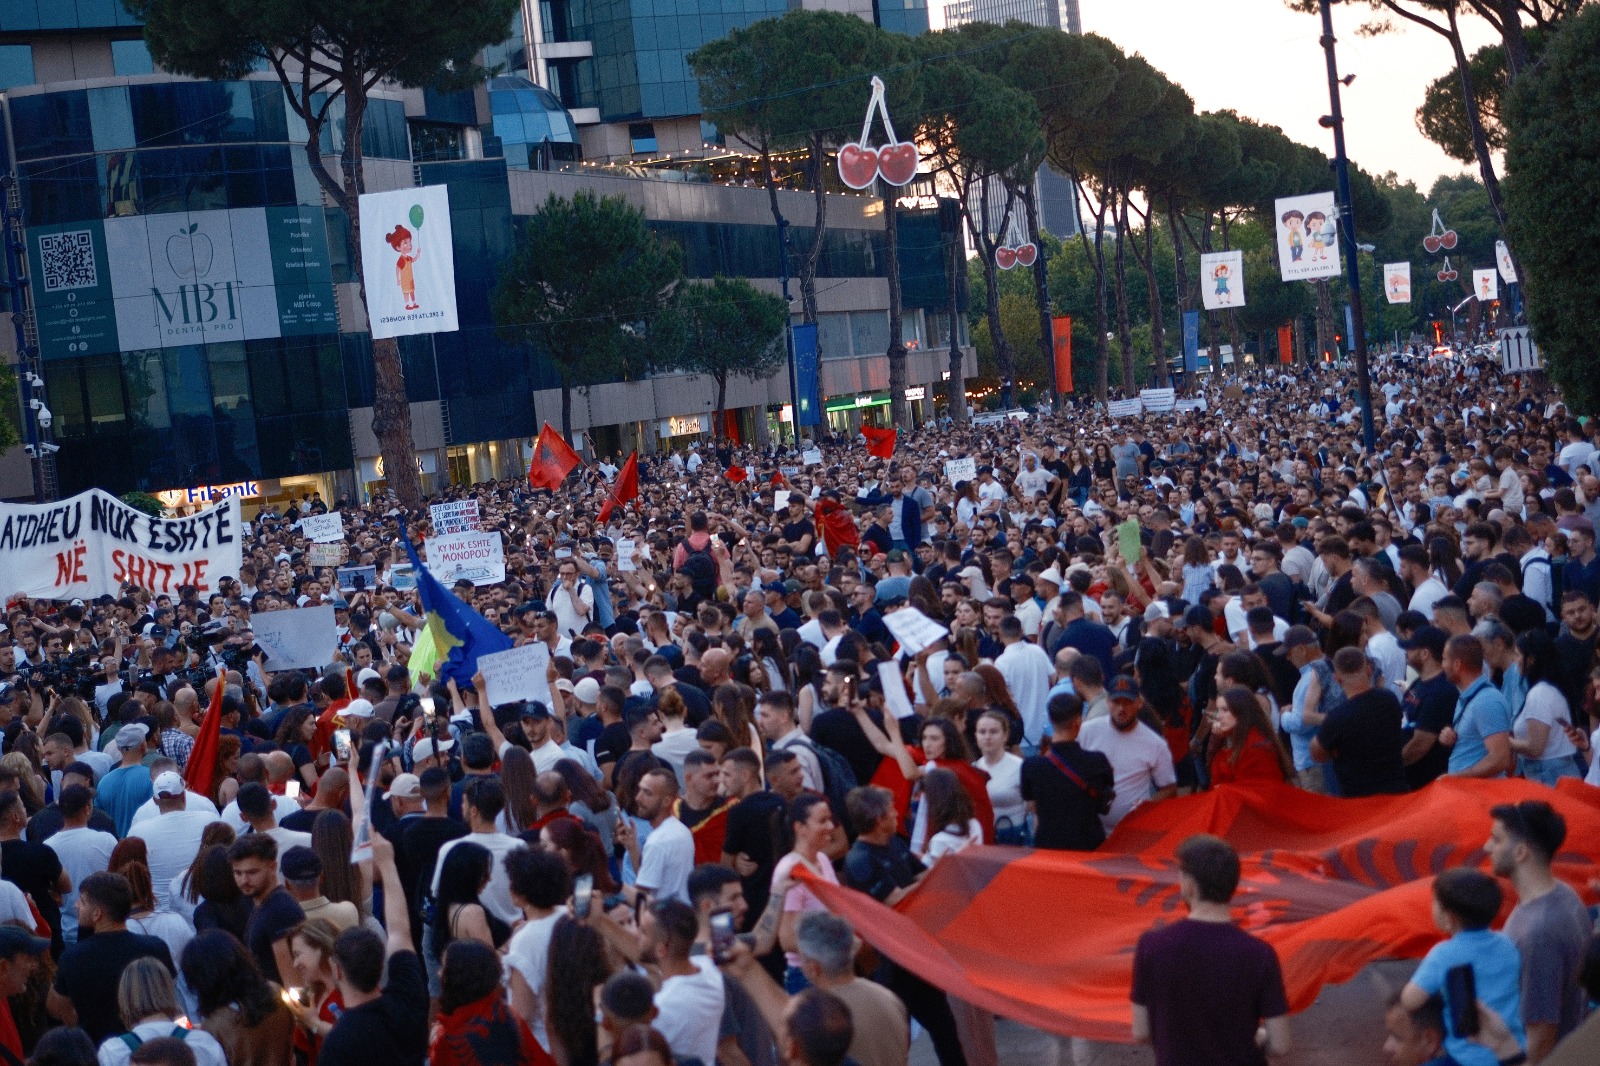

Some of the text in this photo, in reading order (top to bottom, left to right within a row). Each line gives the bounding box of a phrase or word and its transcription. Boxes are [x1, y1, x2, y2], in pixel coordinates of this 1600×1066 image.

[149, 280, 243, 327] MBT
[167, 326, 208, 335] DENTAL
[187, 481, 258, 503] Fibank
[1, 501, 81, 550] ATDHEU
[91, 494, 138, 543] NUK
[438, 540, 491, 553] KY NUK ESHTE
[442, 548, 491, 562] MONOPOLY
[55, 539, 209, 593] NË SHITJE
